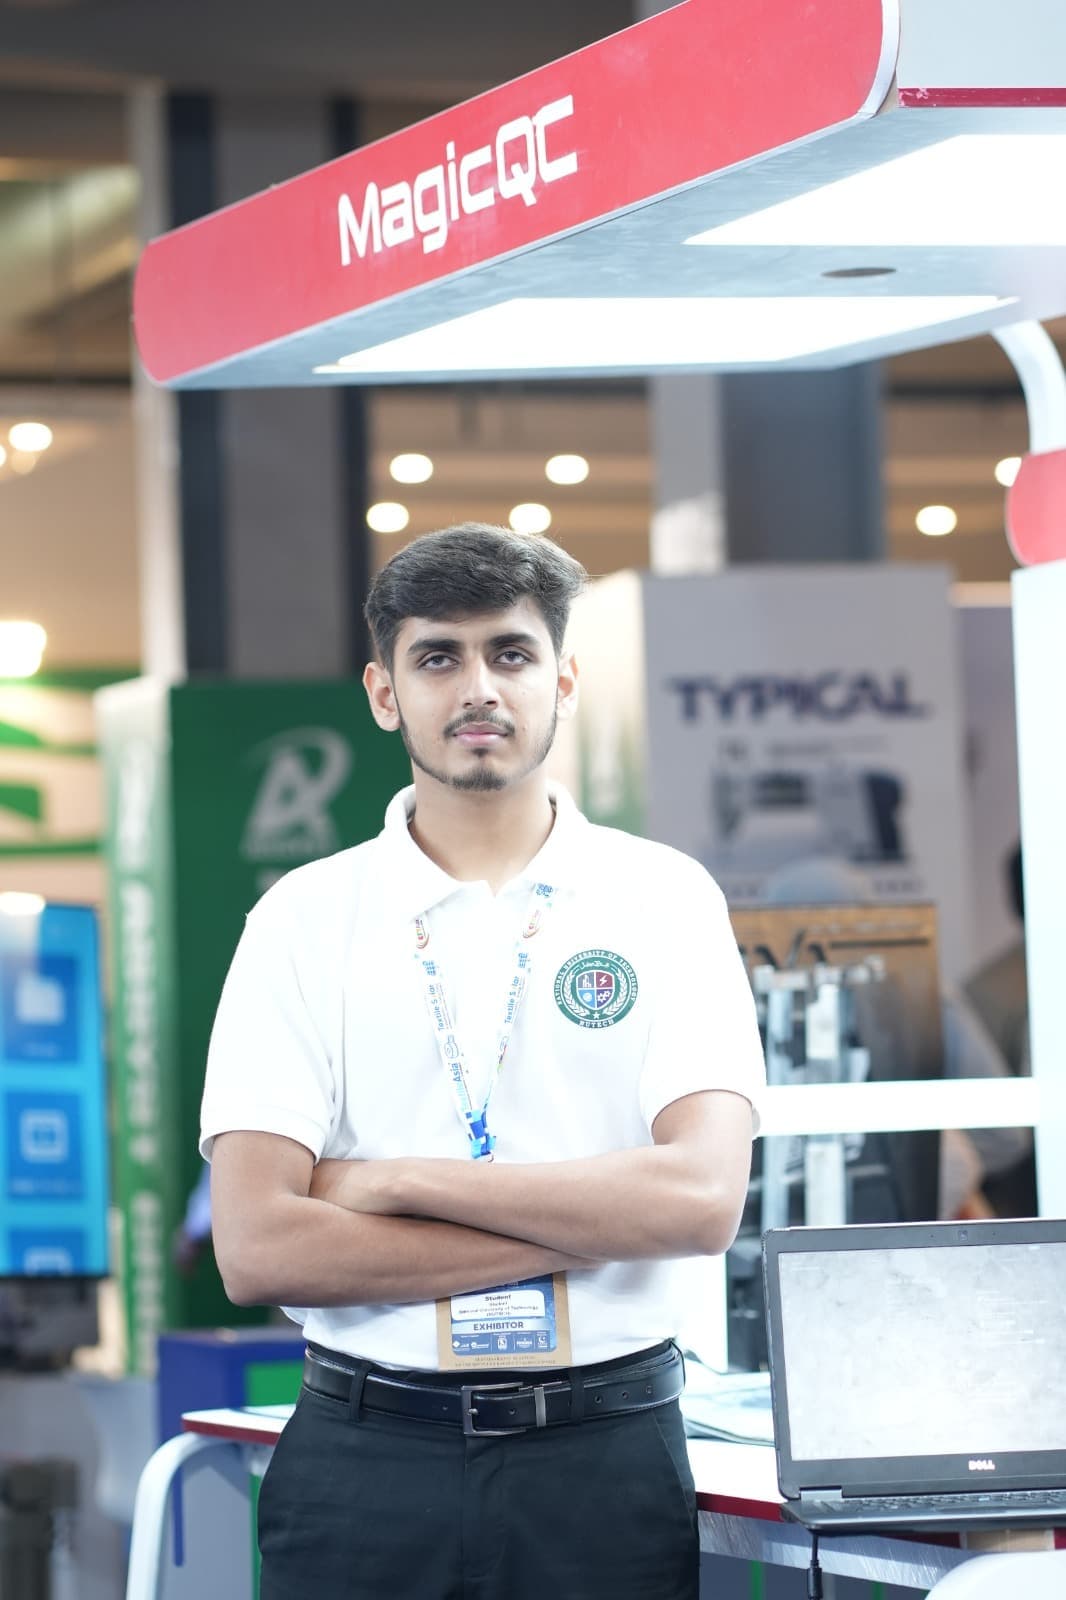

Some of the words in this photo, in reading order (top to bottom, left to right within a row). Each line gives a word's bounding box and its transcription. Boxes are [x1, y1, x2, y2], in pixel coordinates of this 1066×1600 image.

[338, 94, 578, 266] MagicQC
[664, 671, 928, 722] TYPICAL
[452, 1063, 462, 1083] Asia
[473, 1321, 525, 1331] EXHIBITOR
[968, 1459, 996, 1471] DELL
